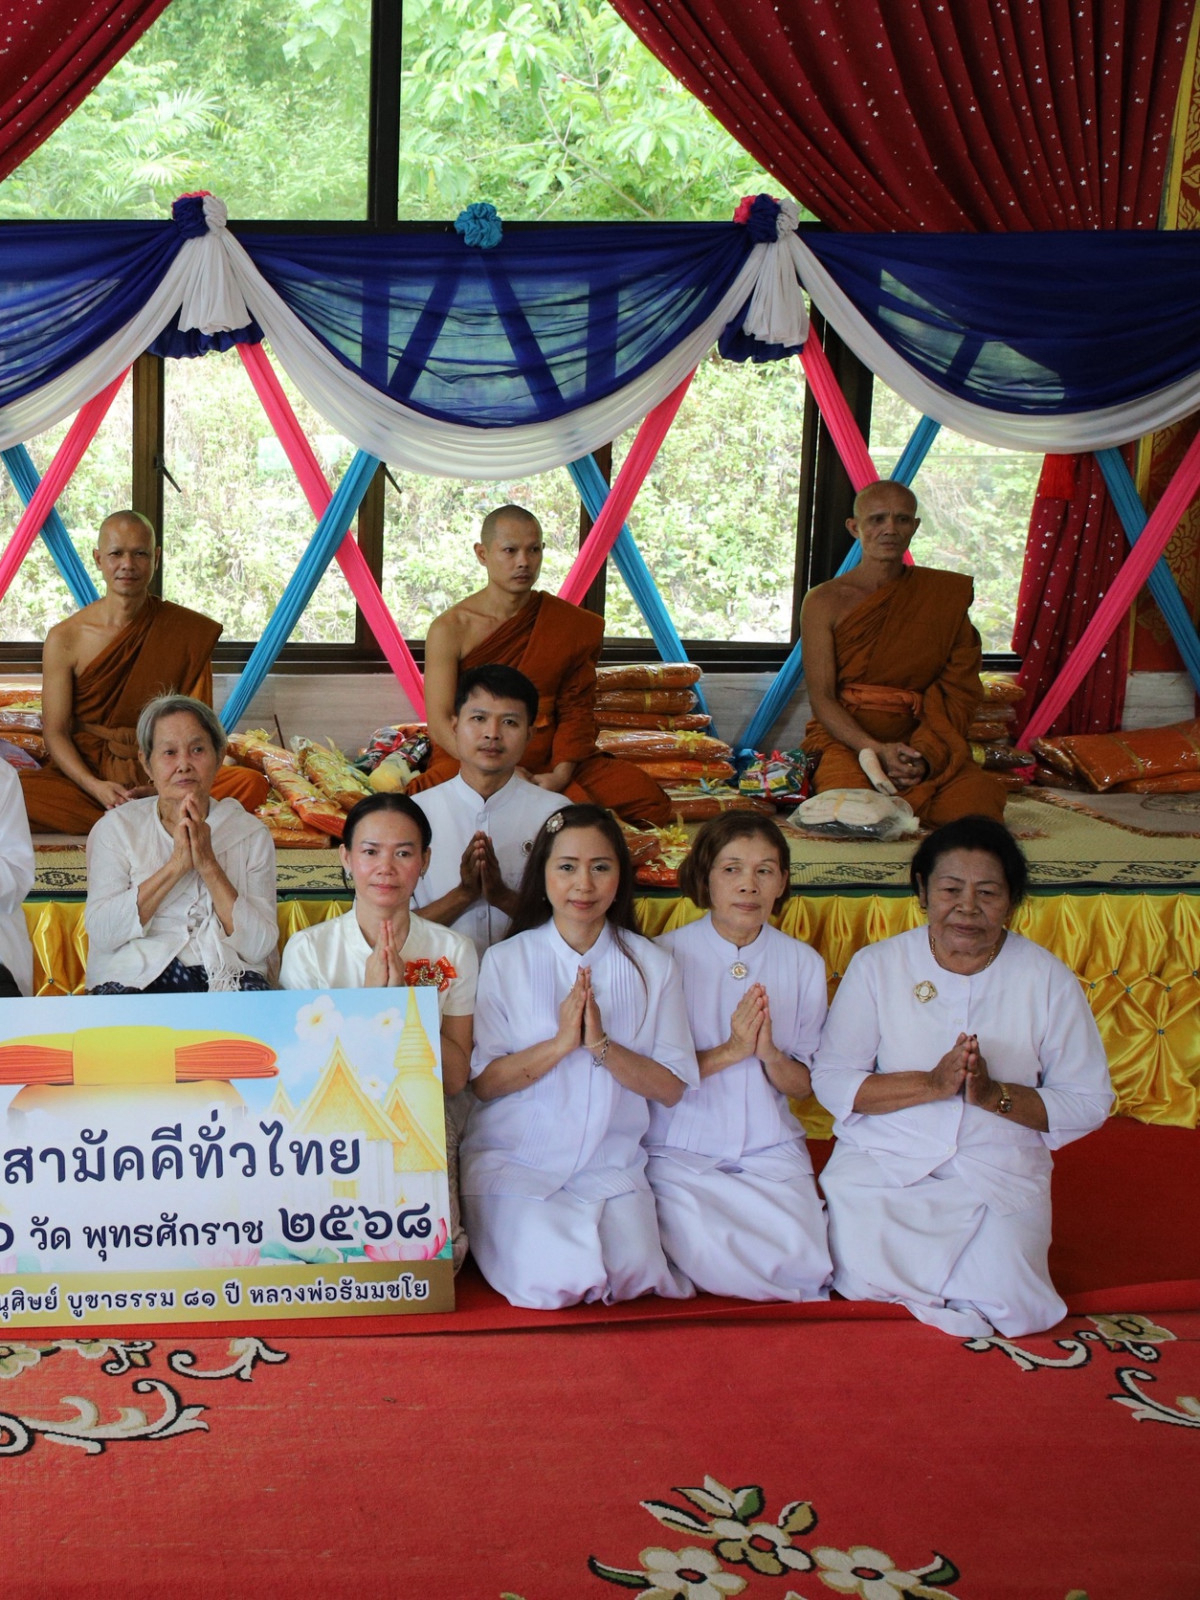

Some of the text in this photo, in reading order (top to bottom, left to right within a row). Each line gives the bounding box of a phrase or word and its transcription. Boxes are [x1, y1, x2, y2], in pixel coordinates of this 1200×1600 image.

[29, 1216, 71, 1250] วัด
[82, 1212, 264, 1262] พุทธศักราช
[278, 1202, 432, 1243] ๒๕๖๘
[67, 1291, 174, 1318] บูชาธรรม
[183, 1290, 216, 1307] ๘๑
[224, 1281, 240, 1304] ปี
[249, 1275, 428, 1304] หลวงพ่อธัมมชโย
